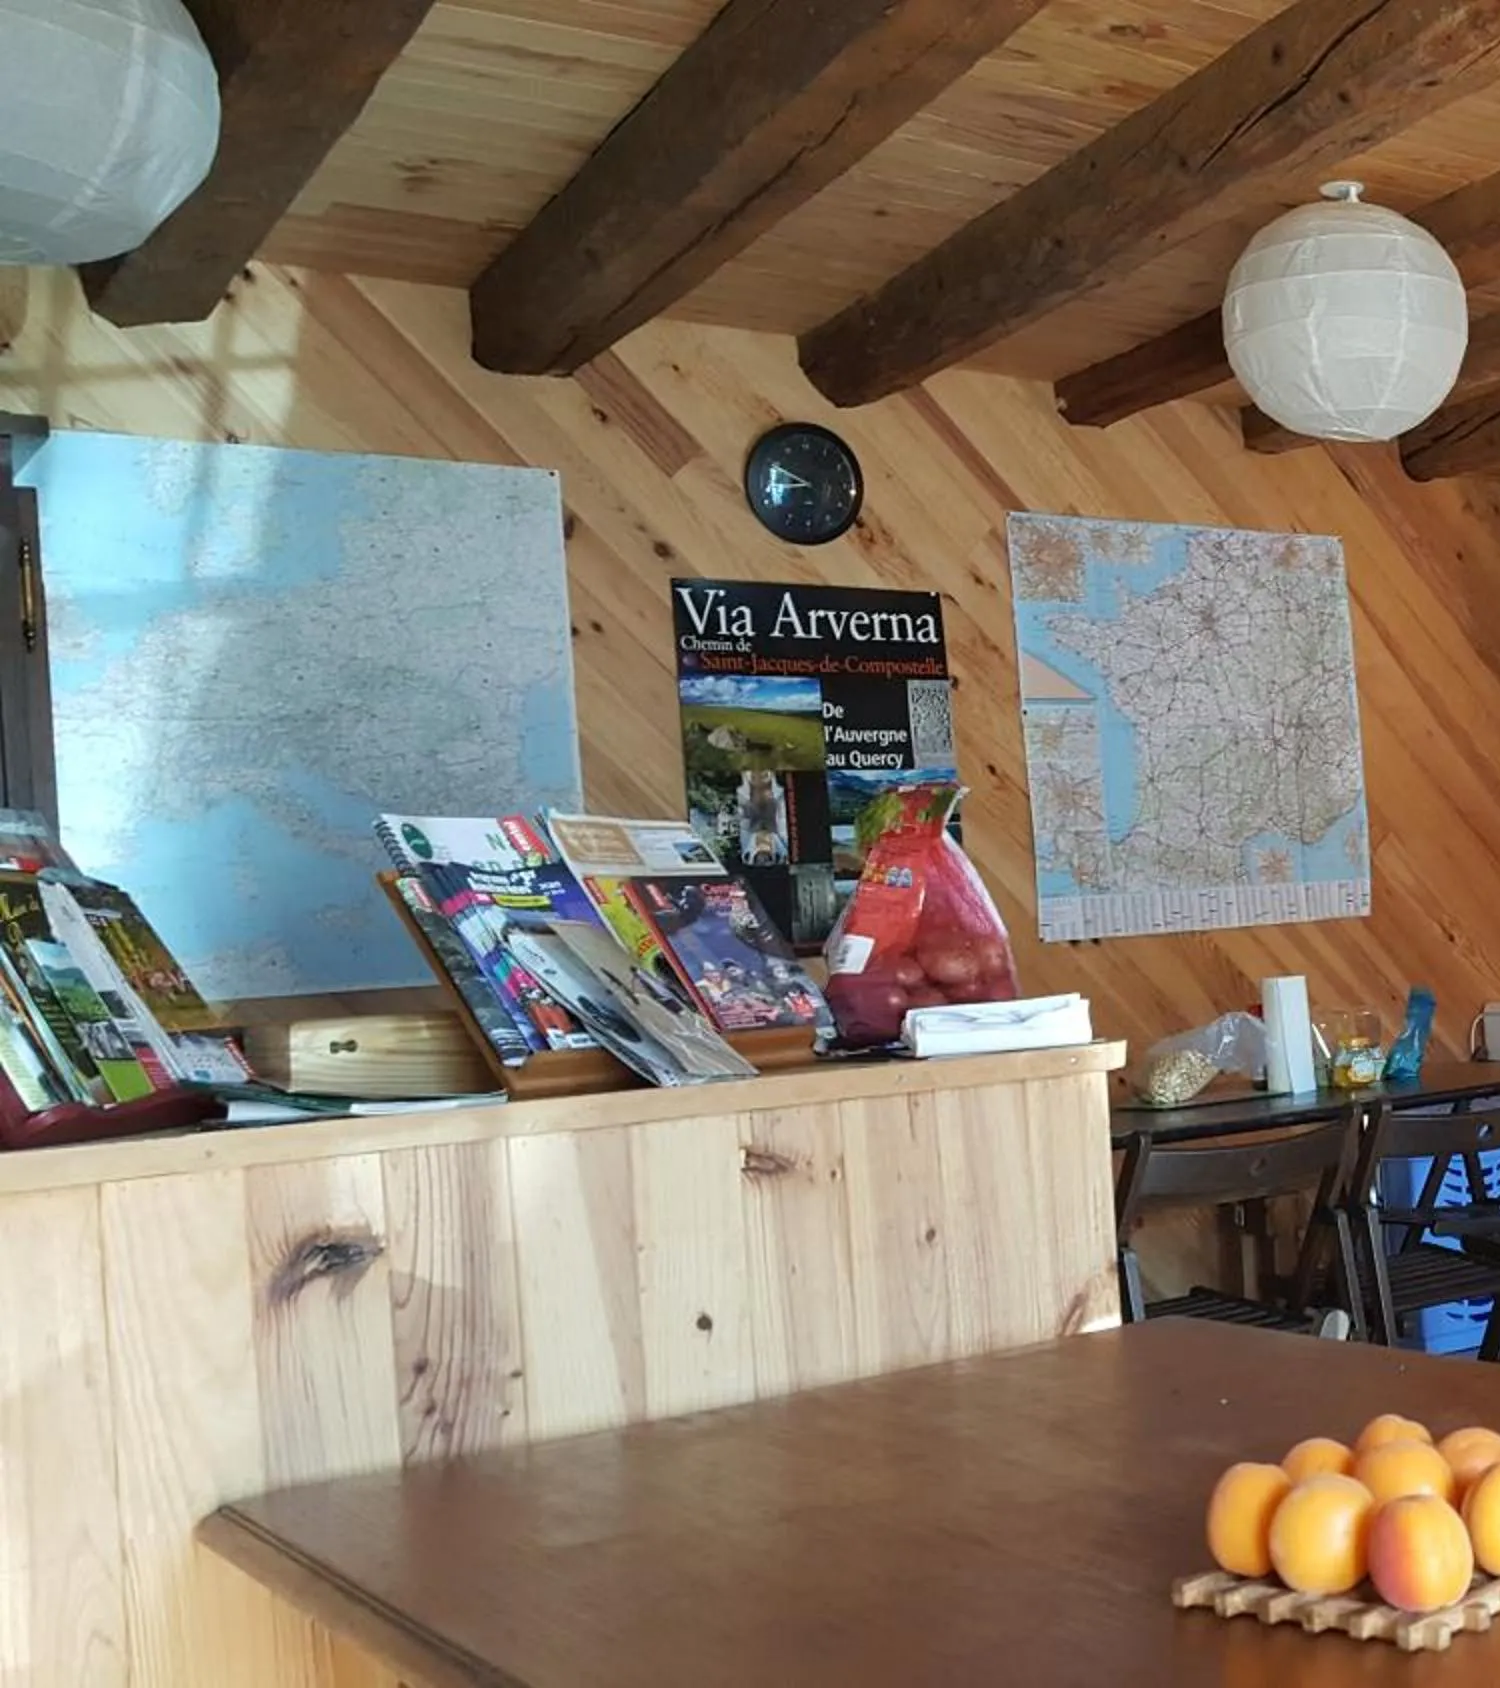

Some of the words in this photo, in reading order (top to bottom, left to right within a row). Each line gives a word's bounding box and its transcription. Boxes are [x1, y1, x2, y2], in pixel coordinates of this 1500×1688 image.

[676, 587, 755, 638] Via
[769, 591, 940, 643] Arverna
[680, 634, 733, 652] Chemin
[735, 637, 752, 653] de
[701, 652, 946, 678] Saint-Jacques-de-Compostelle
[822, 701, 845, 719] De
[823, 725, 908, 747] l'Auvergne
[825, 752, 846, 767] au
[849, 749, 905, 770] Quercy
